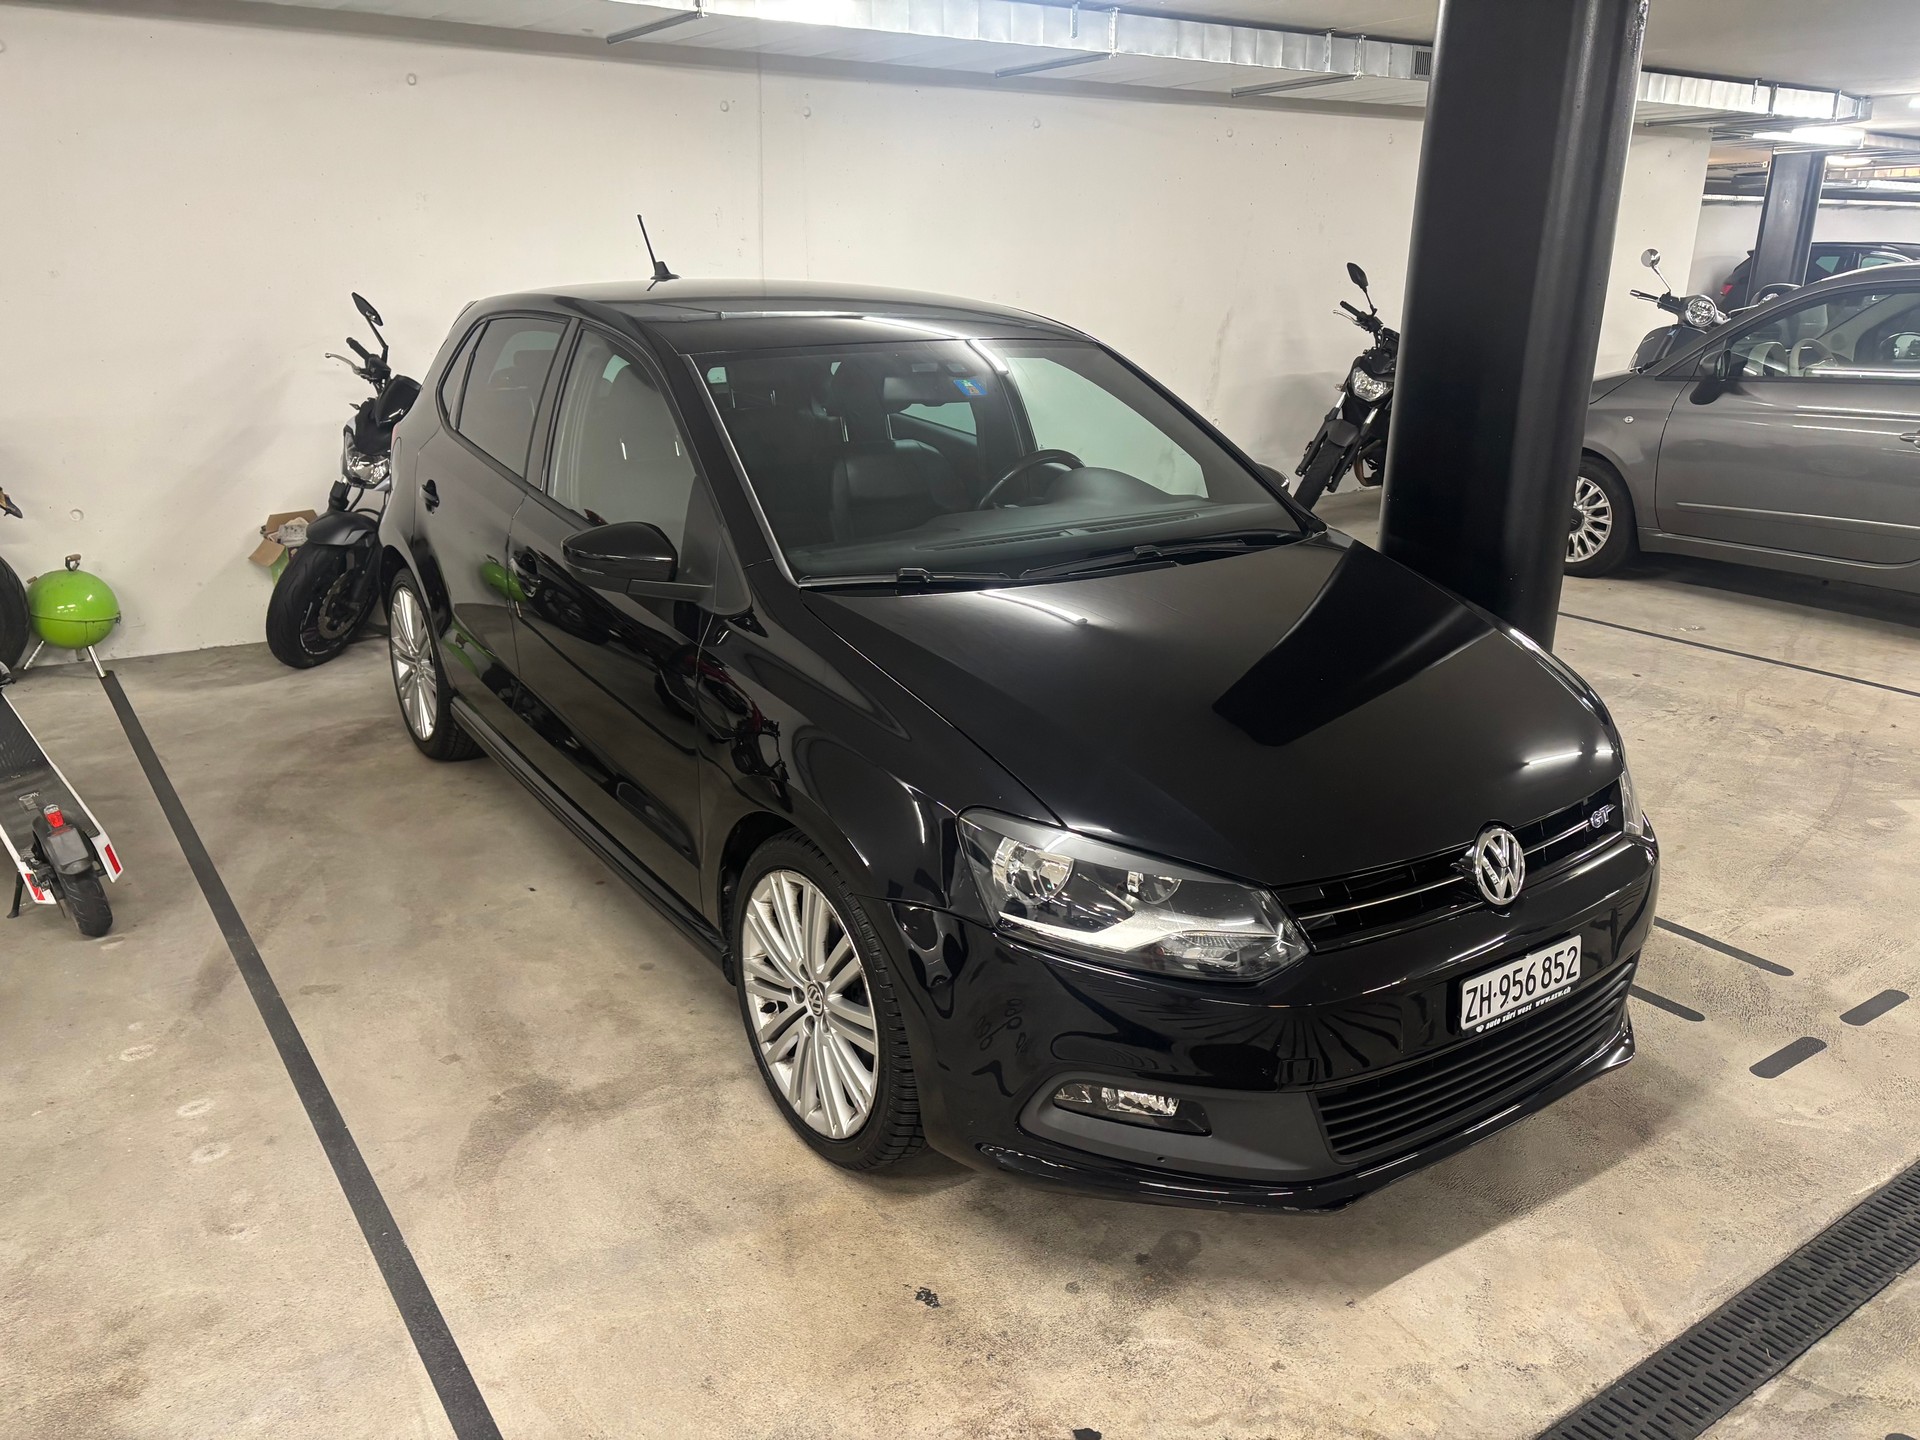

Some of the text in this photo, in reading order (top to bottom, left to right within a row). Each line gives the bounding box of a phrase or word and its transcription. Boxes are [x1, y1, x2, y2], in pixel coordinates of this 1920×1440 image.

[1590, 804, 1616, 828] GT
[1485, 1018, 1501, 1030] auto
[1517, 1003, 1533, 1016] west
